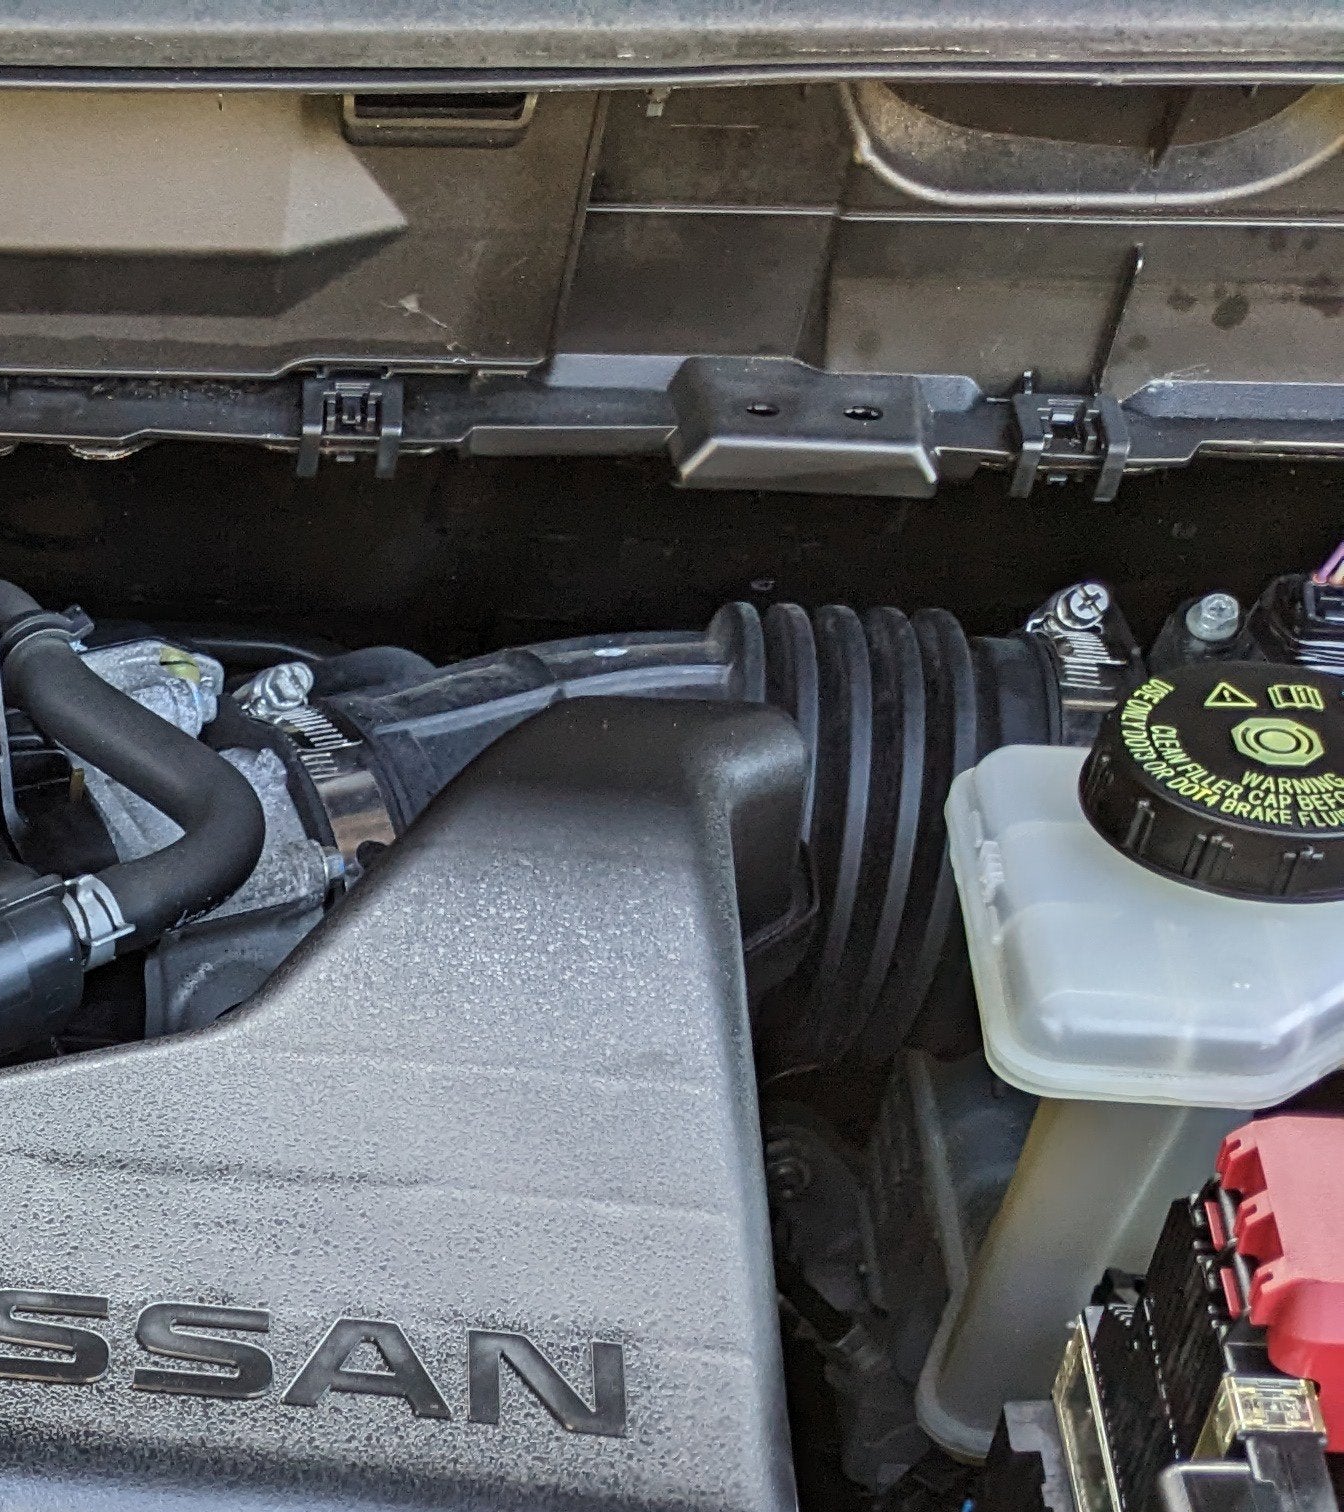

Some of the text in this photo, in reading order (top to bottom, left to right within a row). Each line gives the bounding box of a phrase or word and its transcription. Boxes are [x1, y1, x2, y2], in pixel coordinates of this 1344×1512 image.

[1133, 678, 1175, 705] USE
[1121, 699, 1153, 730] ONLY
[1121, 730, 1157, 760] DOT3
[1143, 761, 1175, 781] OR
[1150, 725, 1191, 764] CLEAN
[1176, 762, 1243, 800] FILLER
[1248, 789, 1292, 809] CAP
[1241, 770, 1344, 794] WARNING
[1220, 798, 1293, 825] BRAKE
